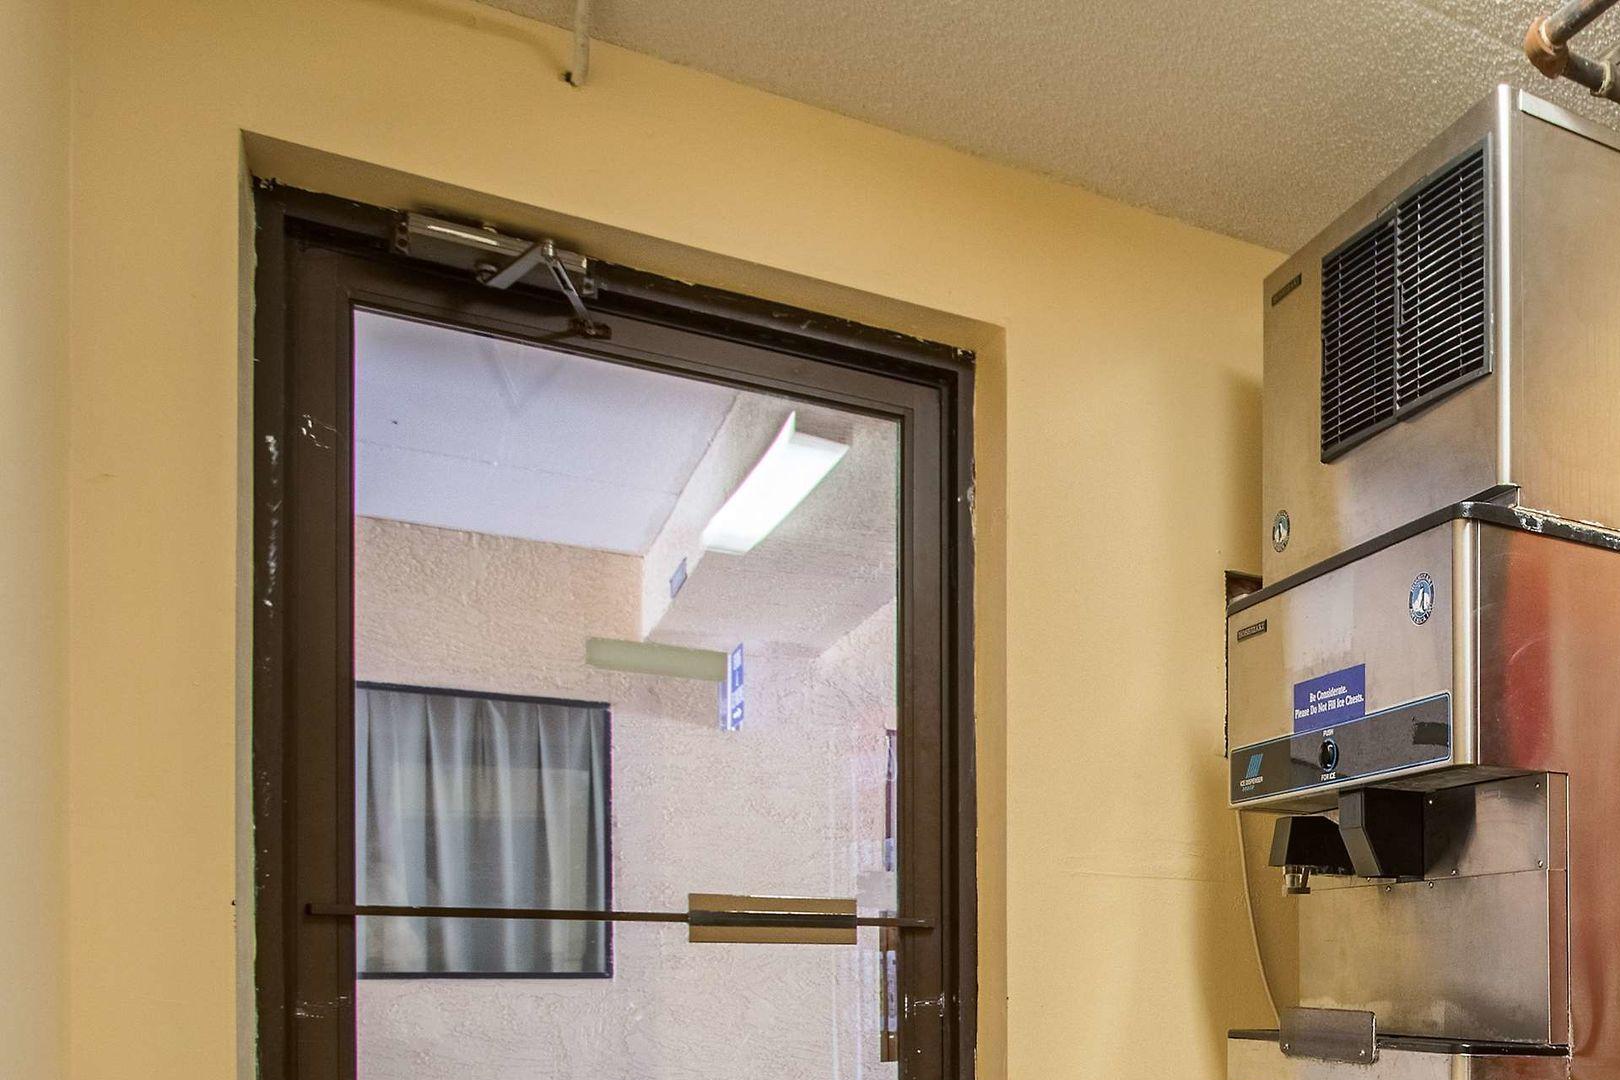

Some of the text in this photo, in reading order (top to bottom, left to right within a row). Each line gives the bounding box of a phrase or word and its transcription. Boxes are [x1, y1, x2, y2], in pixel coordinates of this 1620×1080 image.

[1309, 685, 1348, 703] Be Considerate.
[1294, 709, 1310, 720] Please
[1310, 705, 1317, 715] Do
[1318, 702, 1328, 713] Not
[1336, 697, 1345, 708] Ice
